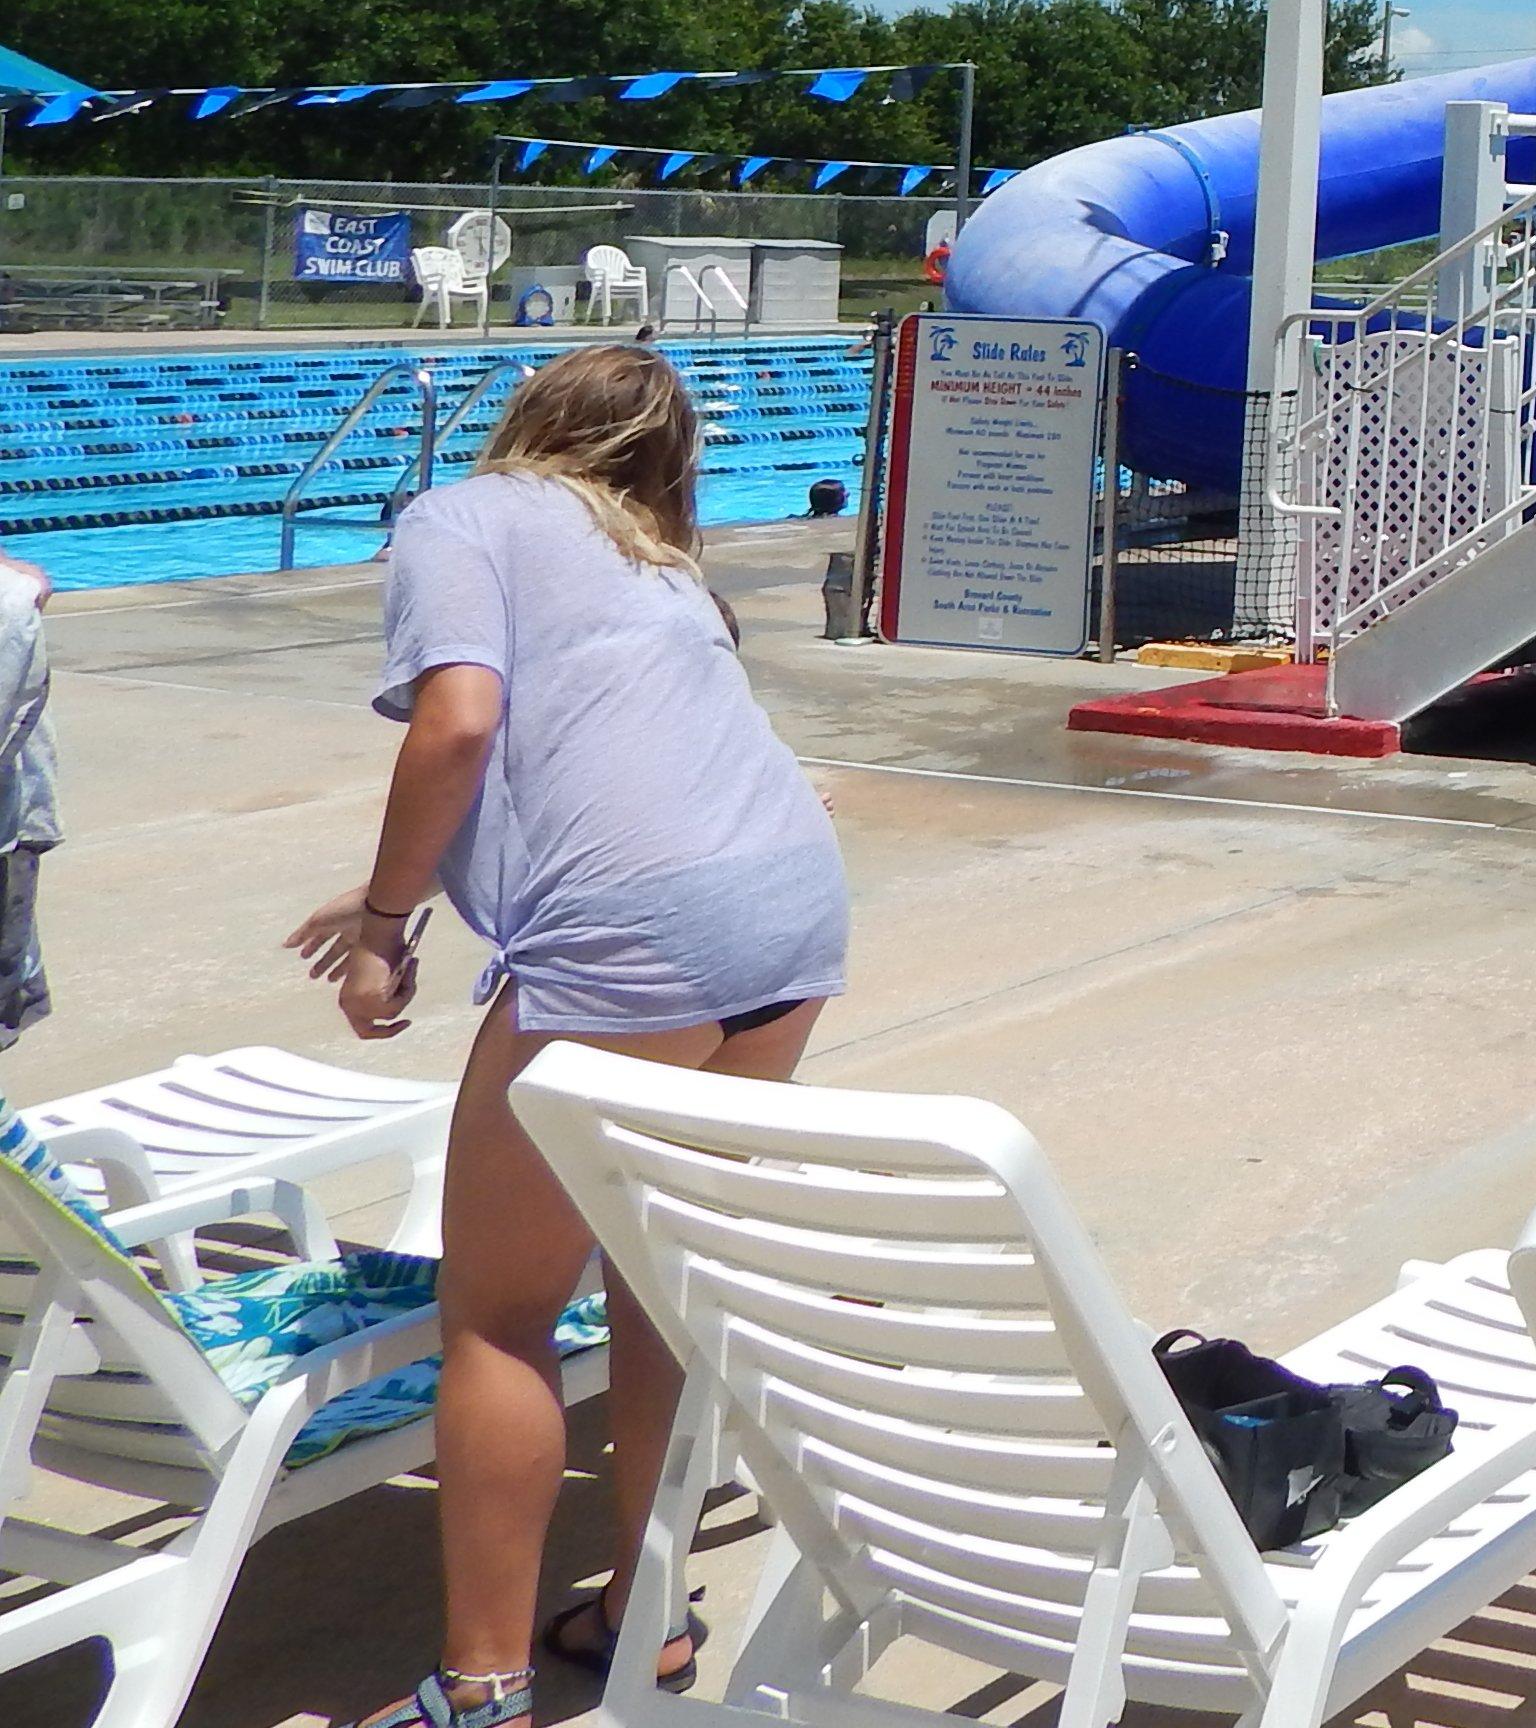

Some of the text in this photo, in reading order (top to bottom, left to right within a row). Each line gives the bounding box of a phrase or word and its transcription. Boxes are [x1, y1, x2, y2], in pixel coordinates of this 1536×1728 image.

[334, 217, 378, 235] EAST
[325, 236, 386, 256] COAST
[303, 257, 401, 277] SWIM CLUB
[972, 341, 1046, 362] Slide Rules
[931, 380, 980, 393] MINIMUM
[984, 381, 1022, 395] HEIGHT
